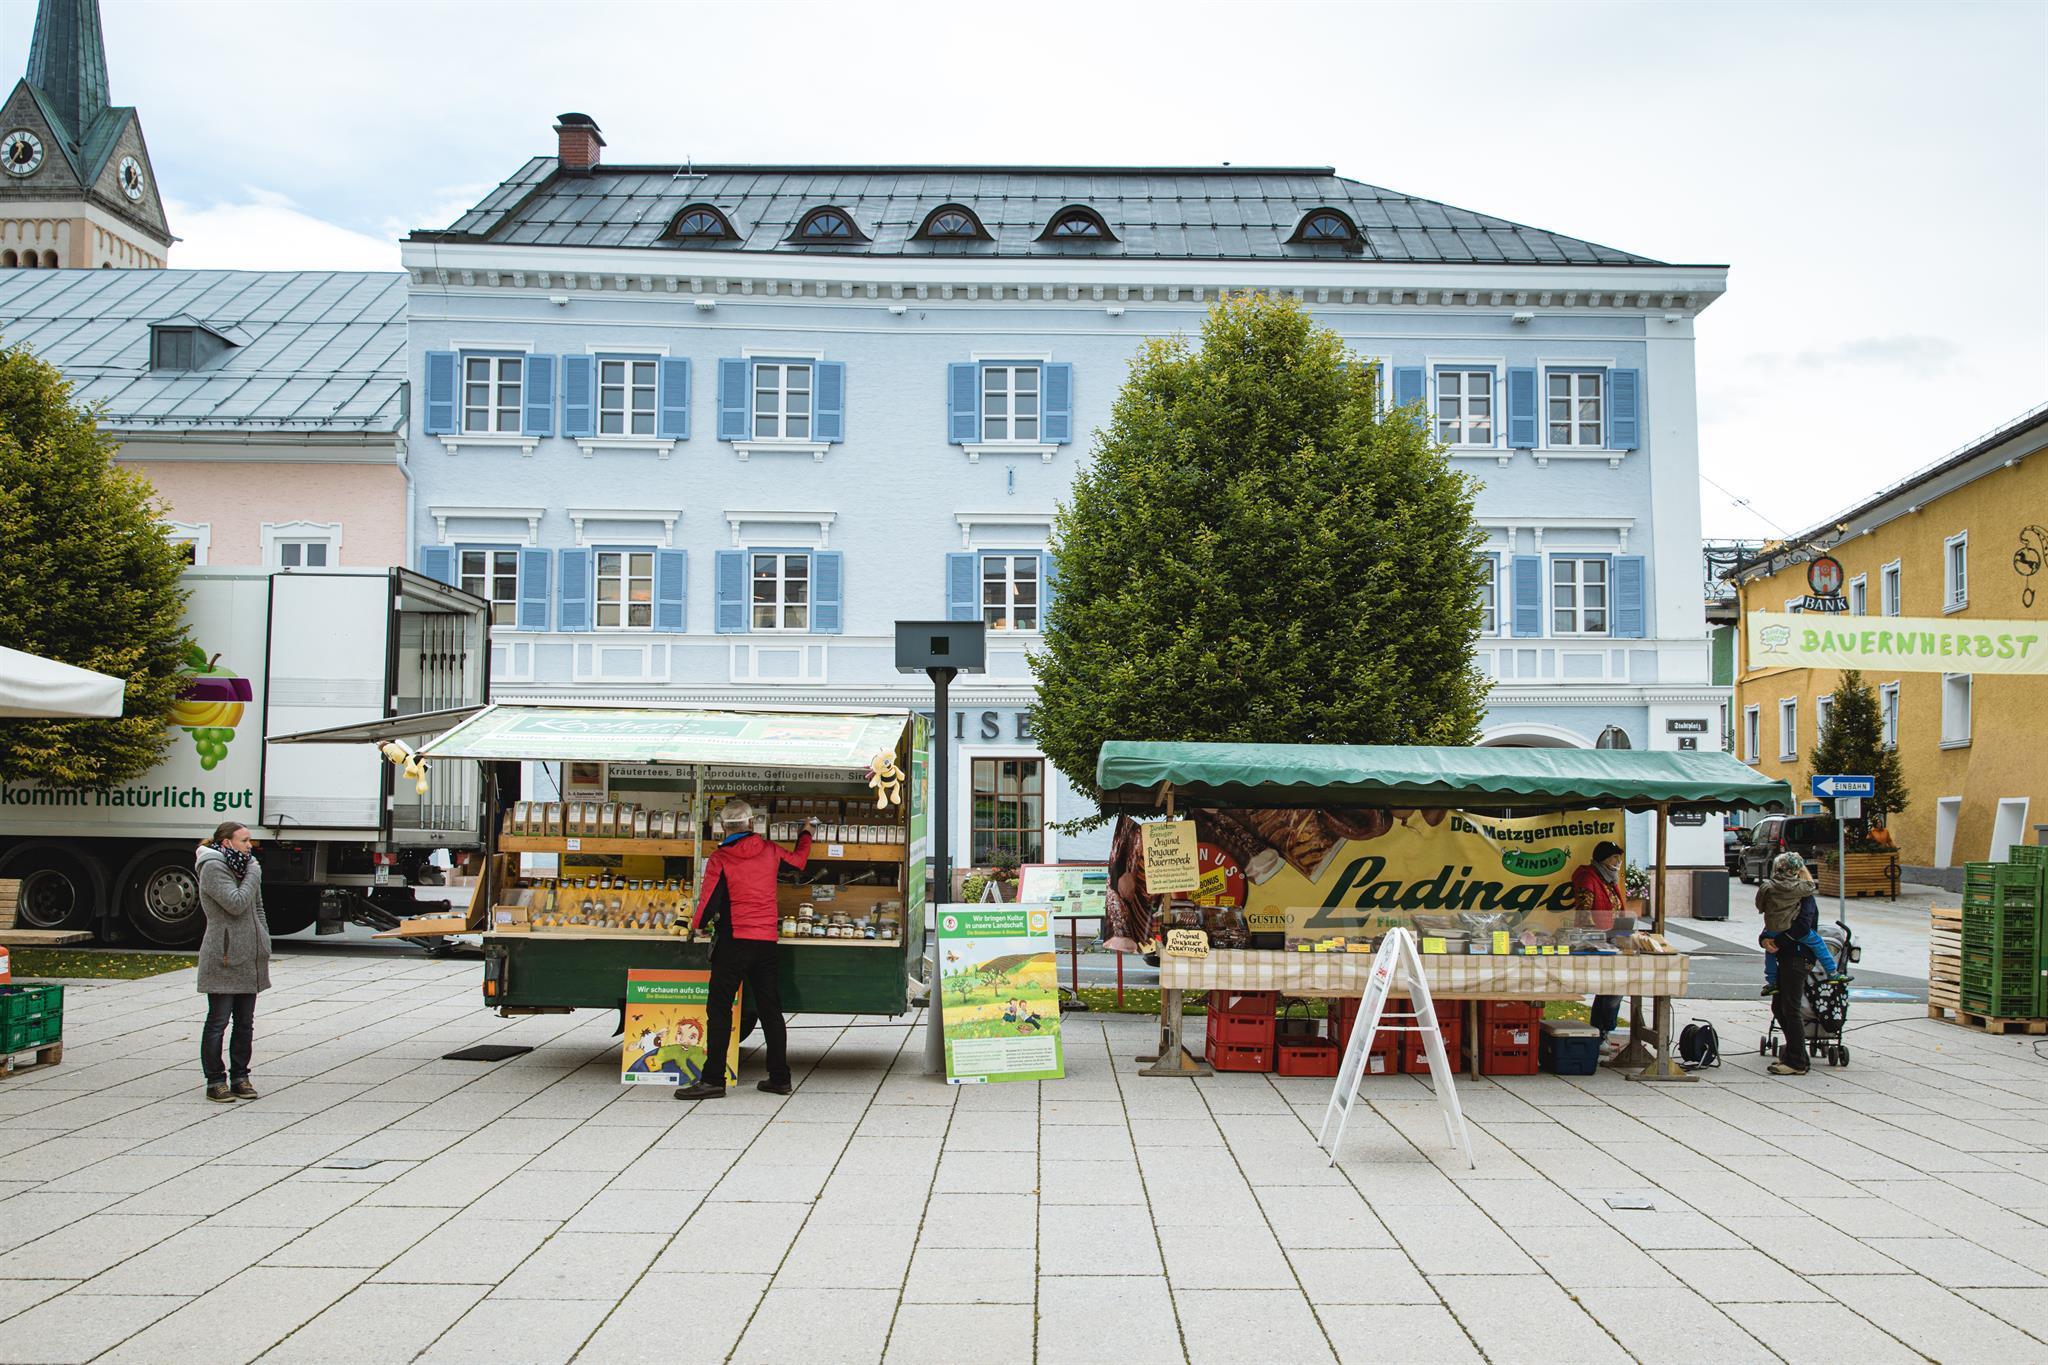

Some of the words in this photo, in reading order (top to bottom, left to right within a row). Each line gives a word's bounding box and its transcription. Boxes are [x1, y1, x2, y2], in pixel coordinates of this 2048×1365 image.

[1804, 597, 1849, 611] BANK
[1800, 629, 2039, 660] BAUERNHERBST
[920, 711, 1037, 740] ISE
[608, 767, 672, 777] Kräutertees,
[676, 768, 760, 780] Biennprodukte,
[703, 782, 786, 793] ww.biokocher.at
[2, 783, 89, 806] kommt
[95, 785, 205, 808] natürlich
[213, 788, 253, 812] gut
[1482, 820, 1616, 844] Metzgermeister
[1154, 836, 1181, 847] Original
[1148, 847, 1179, 859] Pongauer
[1148, 853, 1191, 868] Bauernspeck
[1303, 856, 1576, 930] Ladinge
[1175, 931, 1200, 940] Original
[680, 986, 694, 994] aufs
